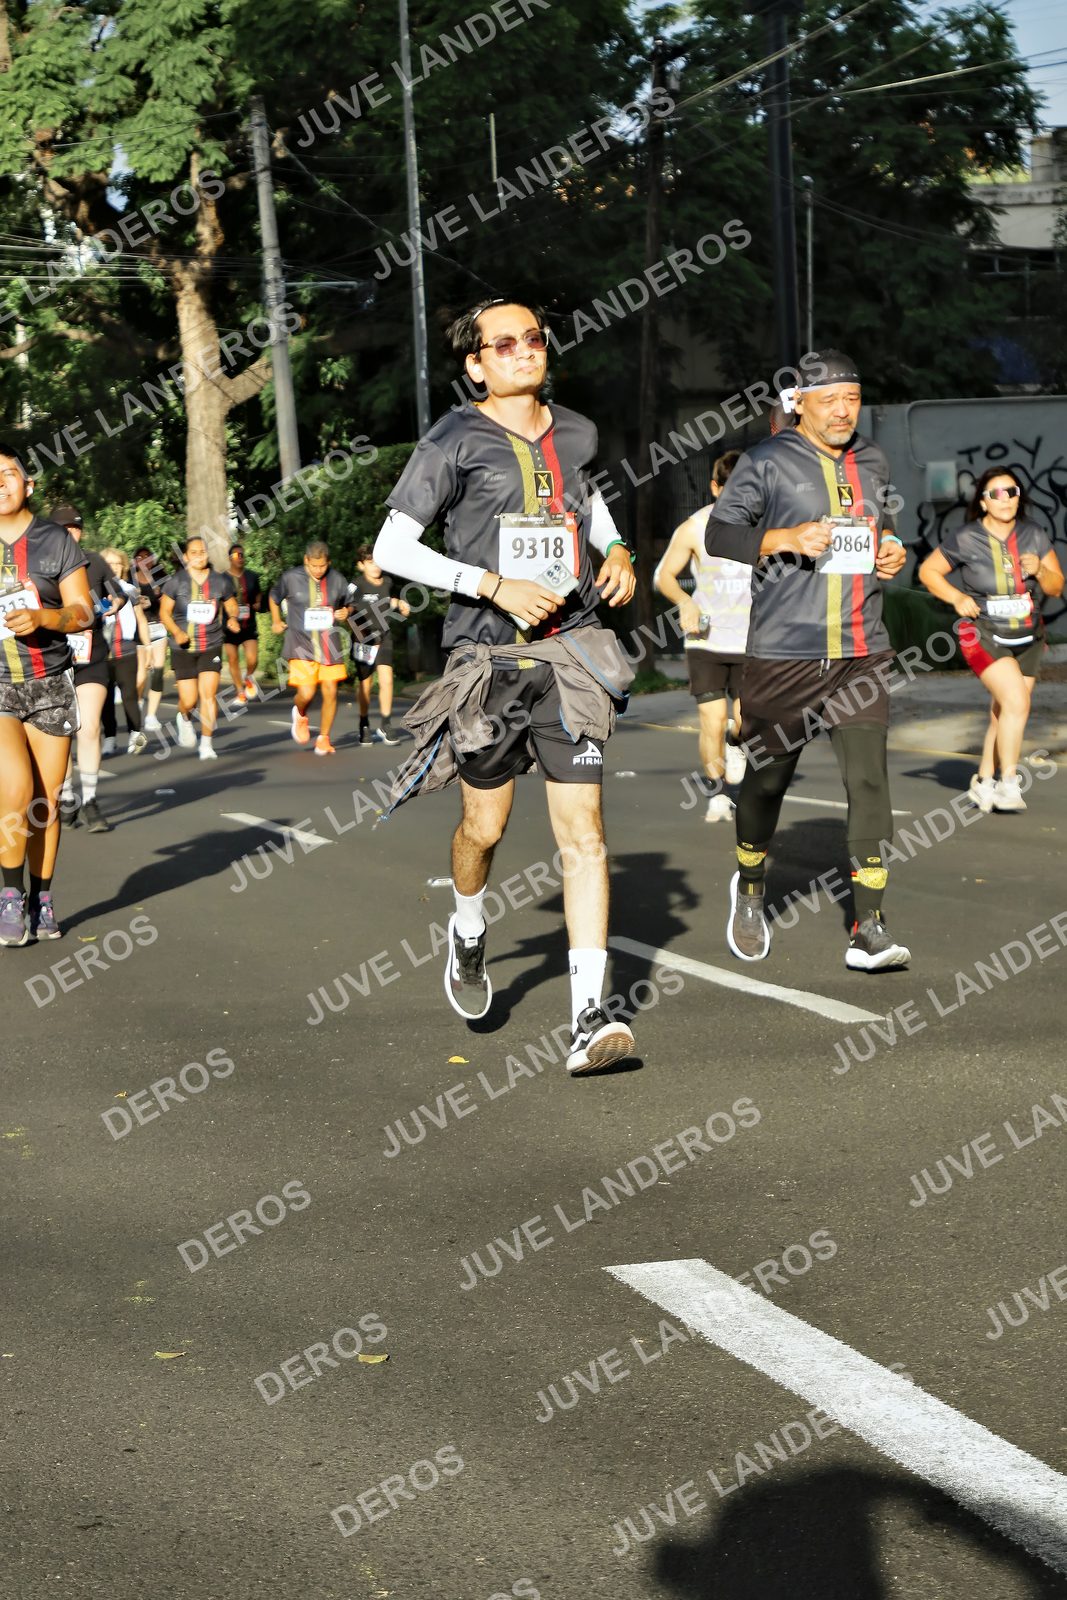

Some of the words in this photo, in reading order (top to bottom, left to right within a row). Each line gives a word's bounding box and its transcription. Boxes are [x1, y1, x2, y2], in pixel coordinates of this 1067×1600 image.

[957, 436, 1043, 469] TOY
[511, 536, 565, 559] 9318
[832, 534, 871, 553] 0864
